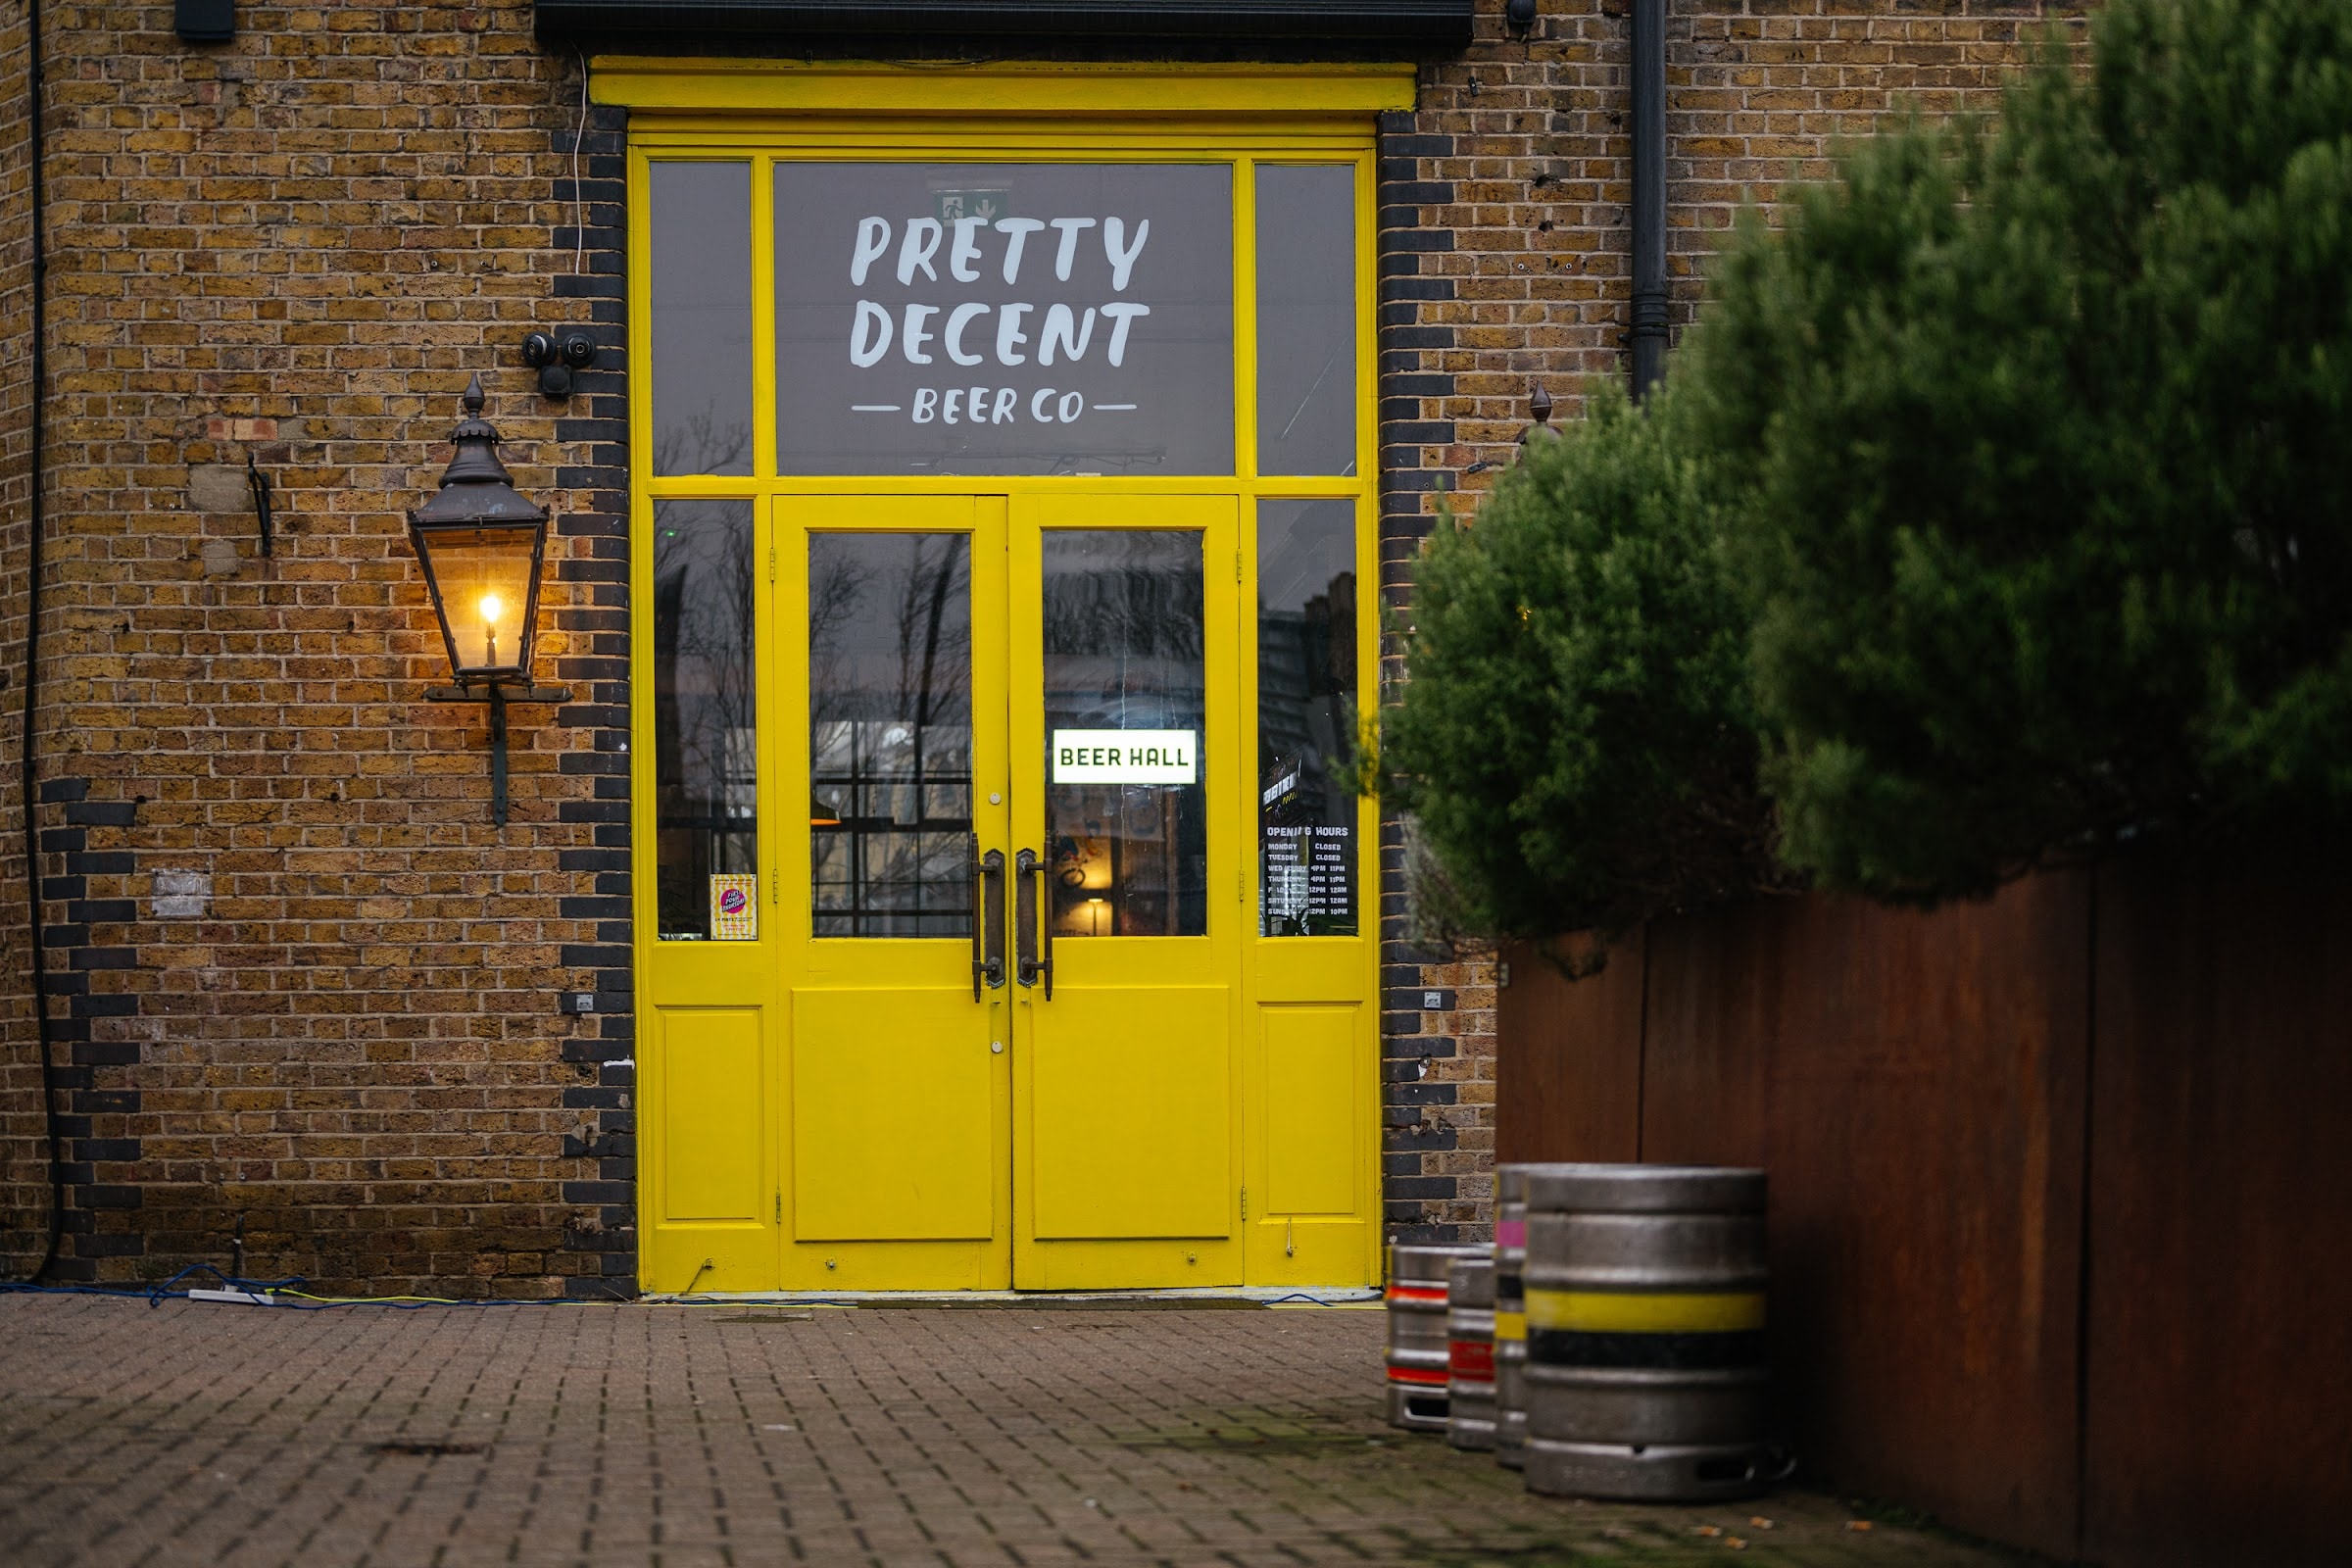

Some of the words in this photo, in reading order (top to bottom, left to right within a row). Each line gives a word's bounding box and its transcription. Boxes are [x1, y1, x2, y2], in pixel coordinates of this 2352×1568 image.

[851, 216, 1150, 291] PRETTY
[851, 299, 1151, 368] DECENT
[911, 386, 1017, 424] BEER
[1031, 388, 1084, 422] CO
[1060, 748, 1122, 766] BEER
[1130, 748, 1189, 766] HALL
[1315, 826, 1348, 837] HOURS
